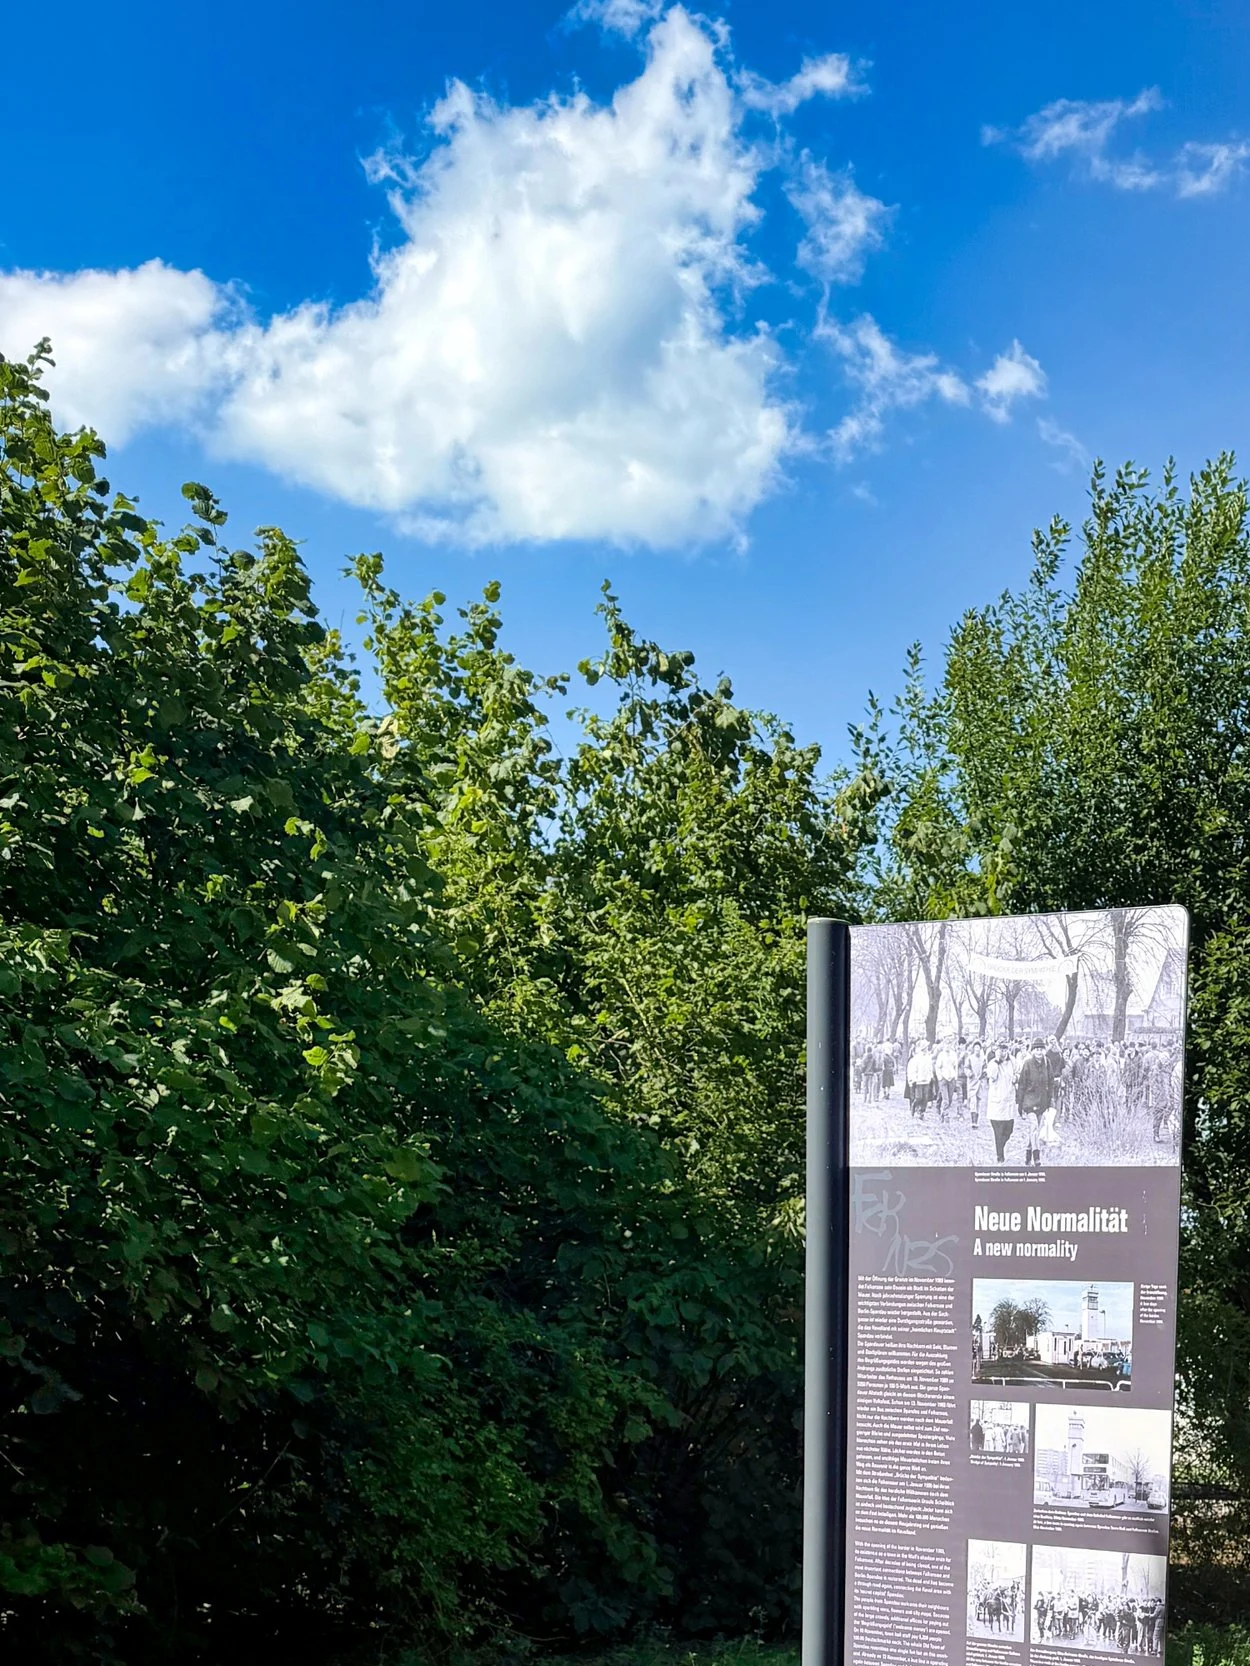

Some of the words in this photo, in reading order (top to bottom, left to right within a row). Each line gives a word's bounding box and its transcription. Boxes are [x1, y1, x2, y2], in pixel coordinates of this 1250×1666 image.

[974, 1205, 1021, 1231] Neue
[1027, 1206, 1128, 1233] Normalität
[974, 1238, 983, 1256] A
[986, 1241, 1013, 1256] new
[1016, 1239, 1078, 1261] normality
